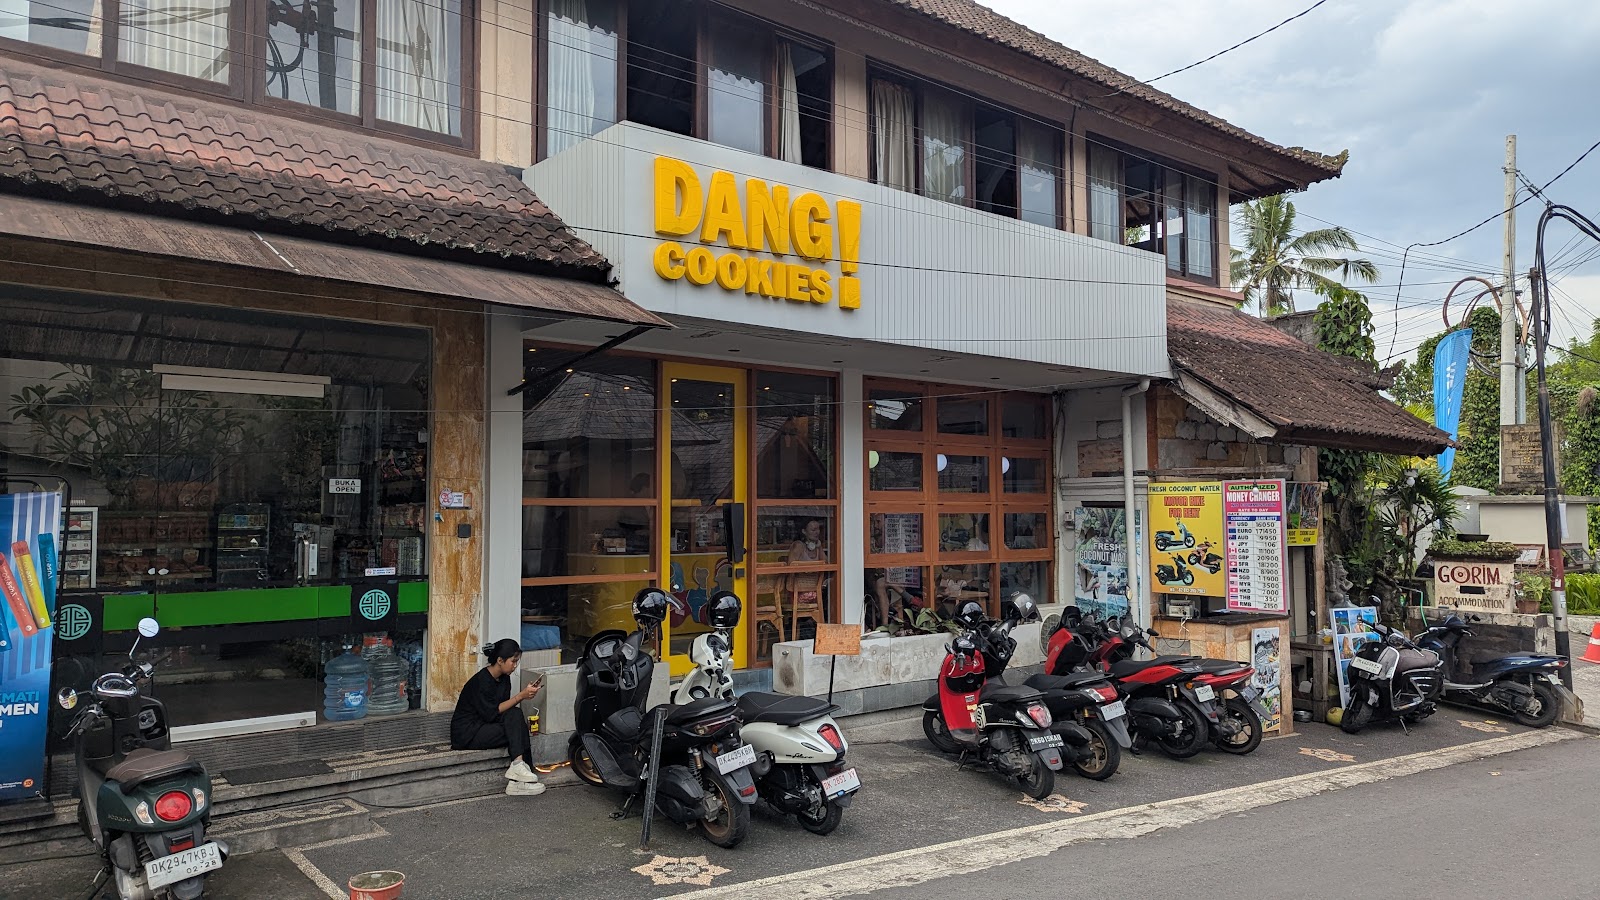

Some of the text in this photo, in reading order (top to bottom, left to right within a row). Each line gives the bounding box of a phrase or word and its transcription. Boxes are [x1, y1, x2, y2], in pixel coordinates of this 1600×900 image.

[654, 156, 862, 309] DANG!
[653, 241, 833, 304] COOKIES
[1149, 485, 1167, 493] FRESH
[1199, 484, 1220, 492] WATER
[1164, 495, 1206, 507] MOTOR BIKE
[1226, 490, 1280, 502] MONEY CHANGER
[1168, 507, 1200, 519] FOR RENT
[1093, 543, 1121, 551] FRESH
[1080, 550, 1110, 562] COCONUT
[0, 690, 39, 704] MATI
[151, 846, 215, 875] DK2947KBJ
